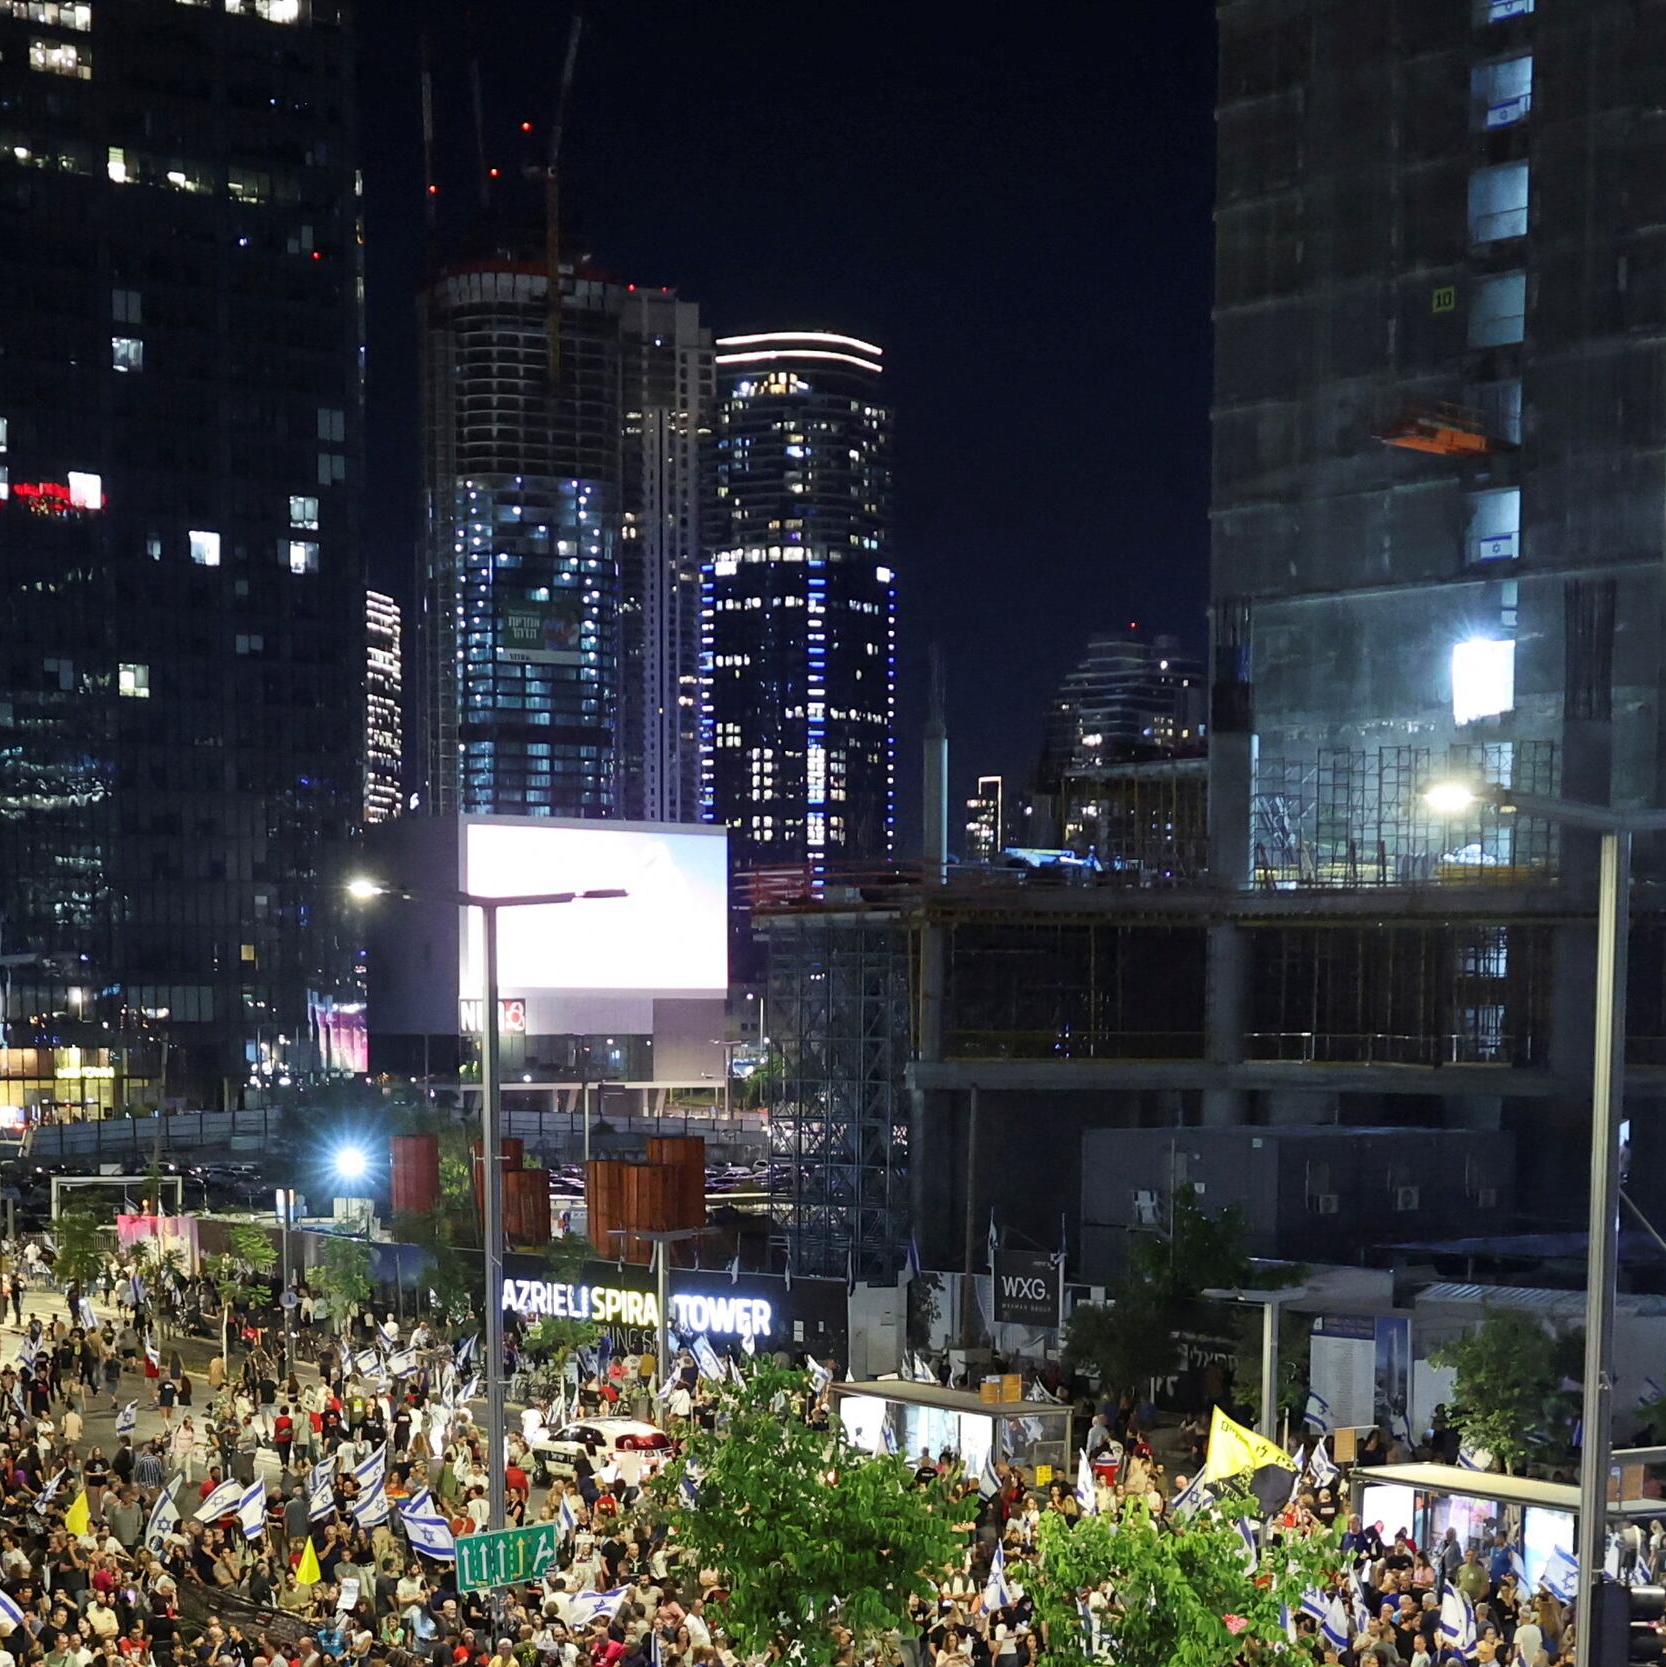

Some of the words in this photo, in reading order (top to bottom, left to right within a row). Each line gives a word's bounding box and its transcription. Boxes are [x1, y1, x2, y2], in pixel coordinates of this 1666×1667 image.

[501, 1278, 590, 1320] AZRIELI
[592, 1286, 663, 1329] SPIRA
[674, 1294, 772, 1337] TOWER
